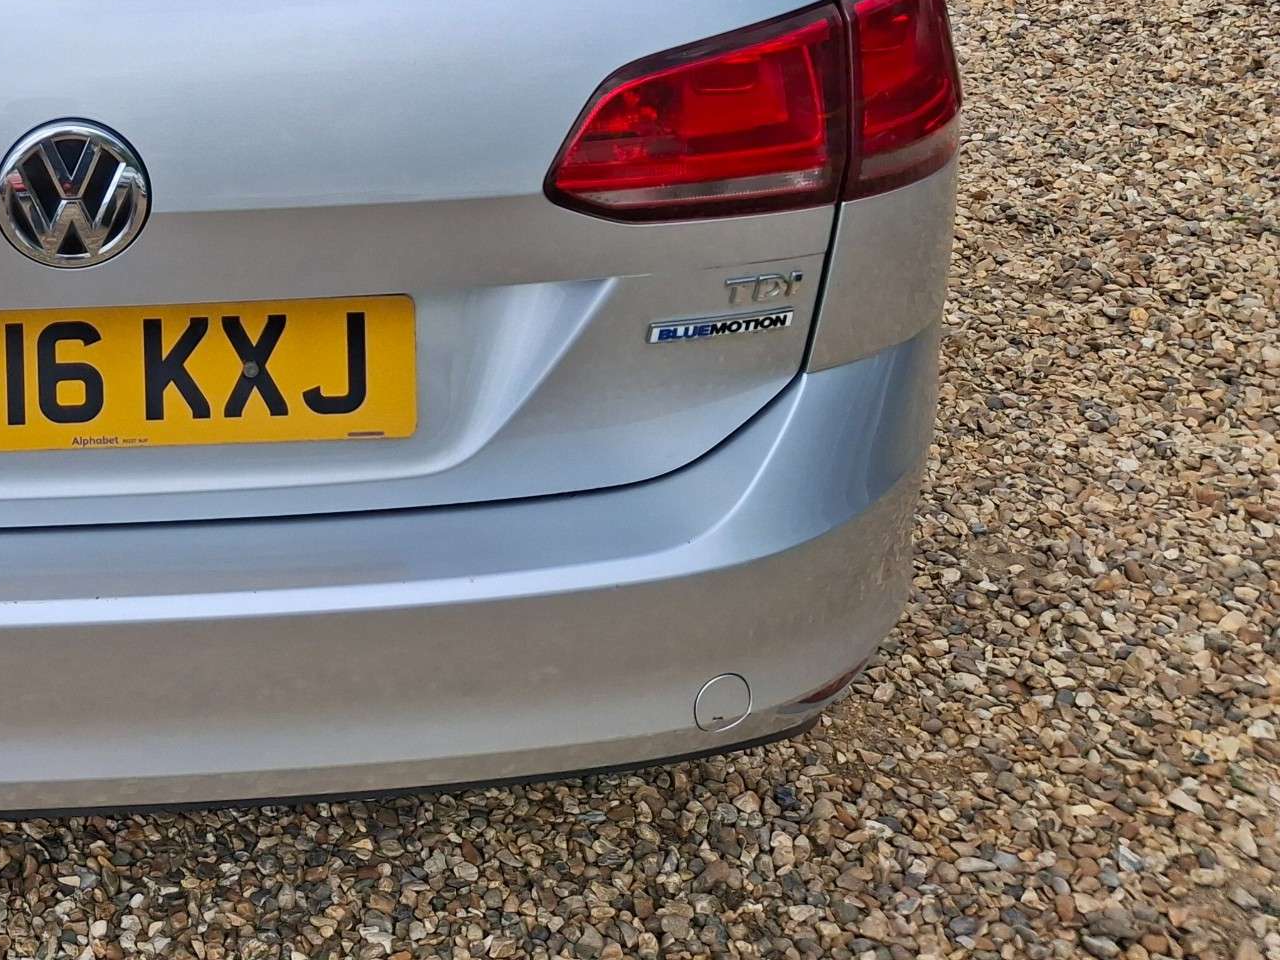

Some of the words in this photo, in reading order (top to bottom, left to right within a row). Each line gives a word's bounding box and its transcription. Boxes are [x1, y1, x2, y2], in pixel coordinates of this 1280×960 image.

[658, 314, 788, 341] BLUEMOTION
[142, 311, 367, 422] KXJ
[71, 435, 119, 447] Alphabet
